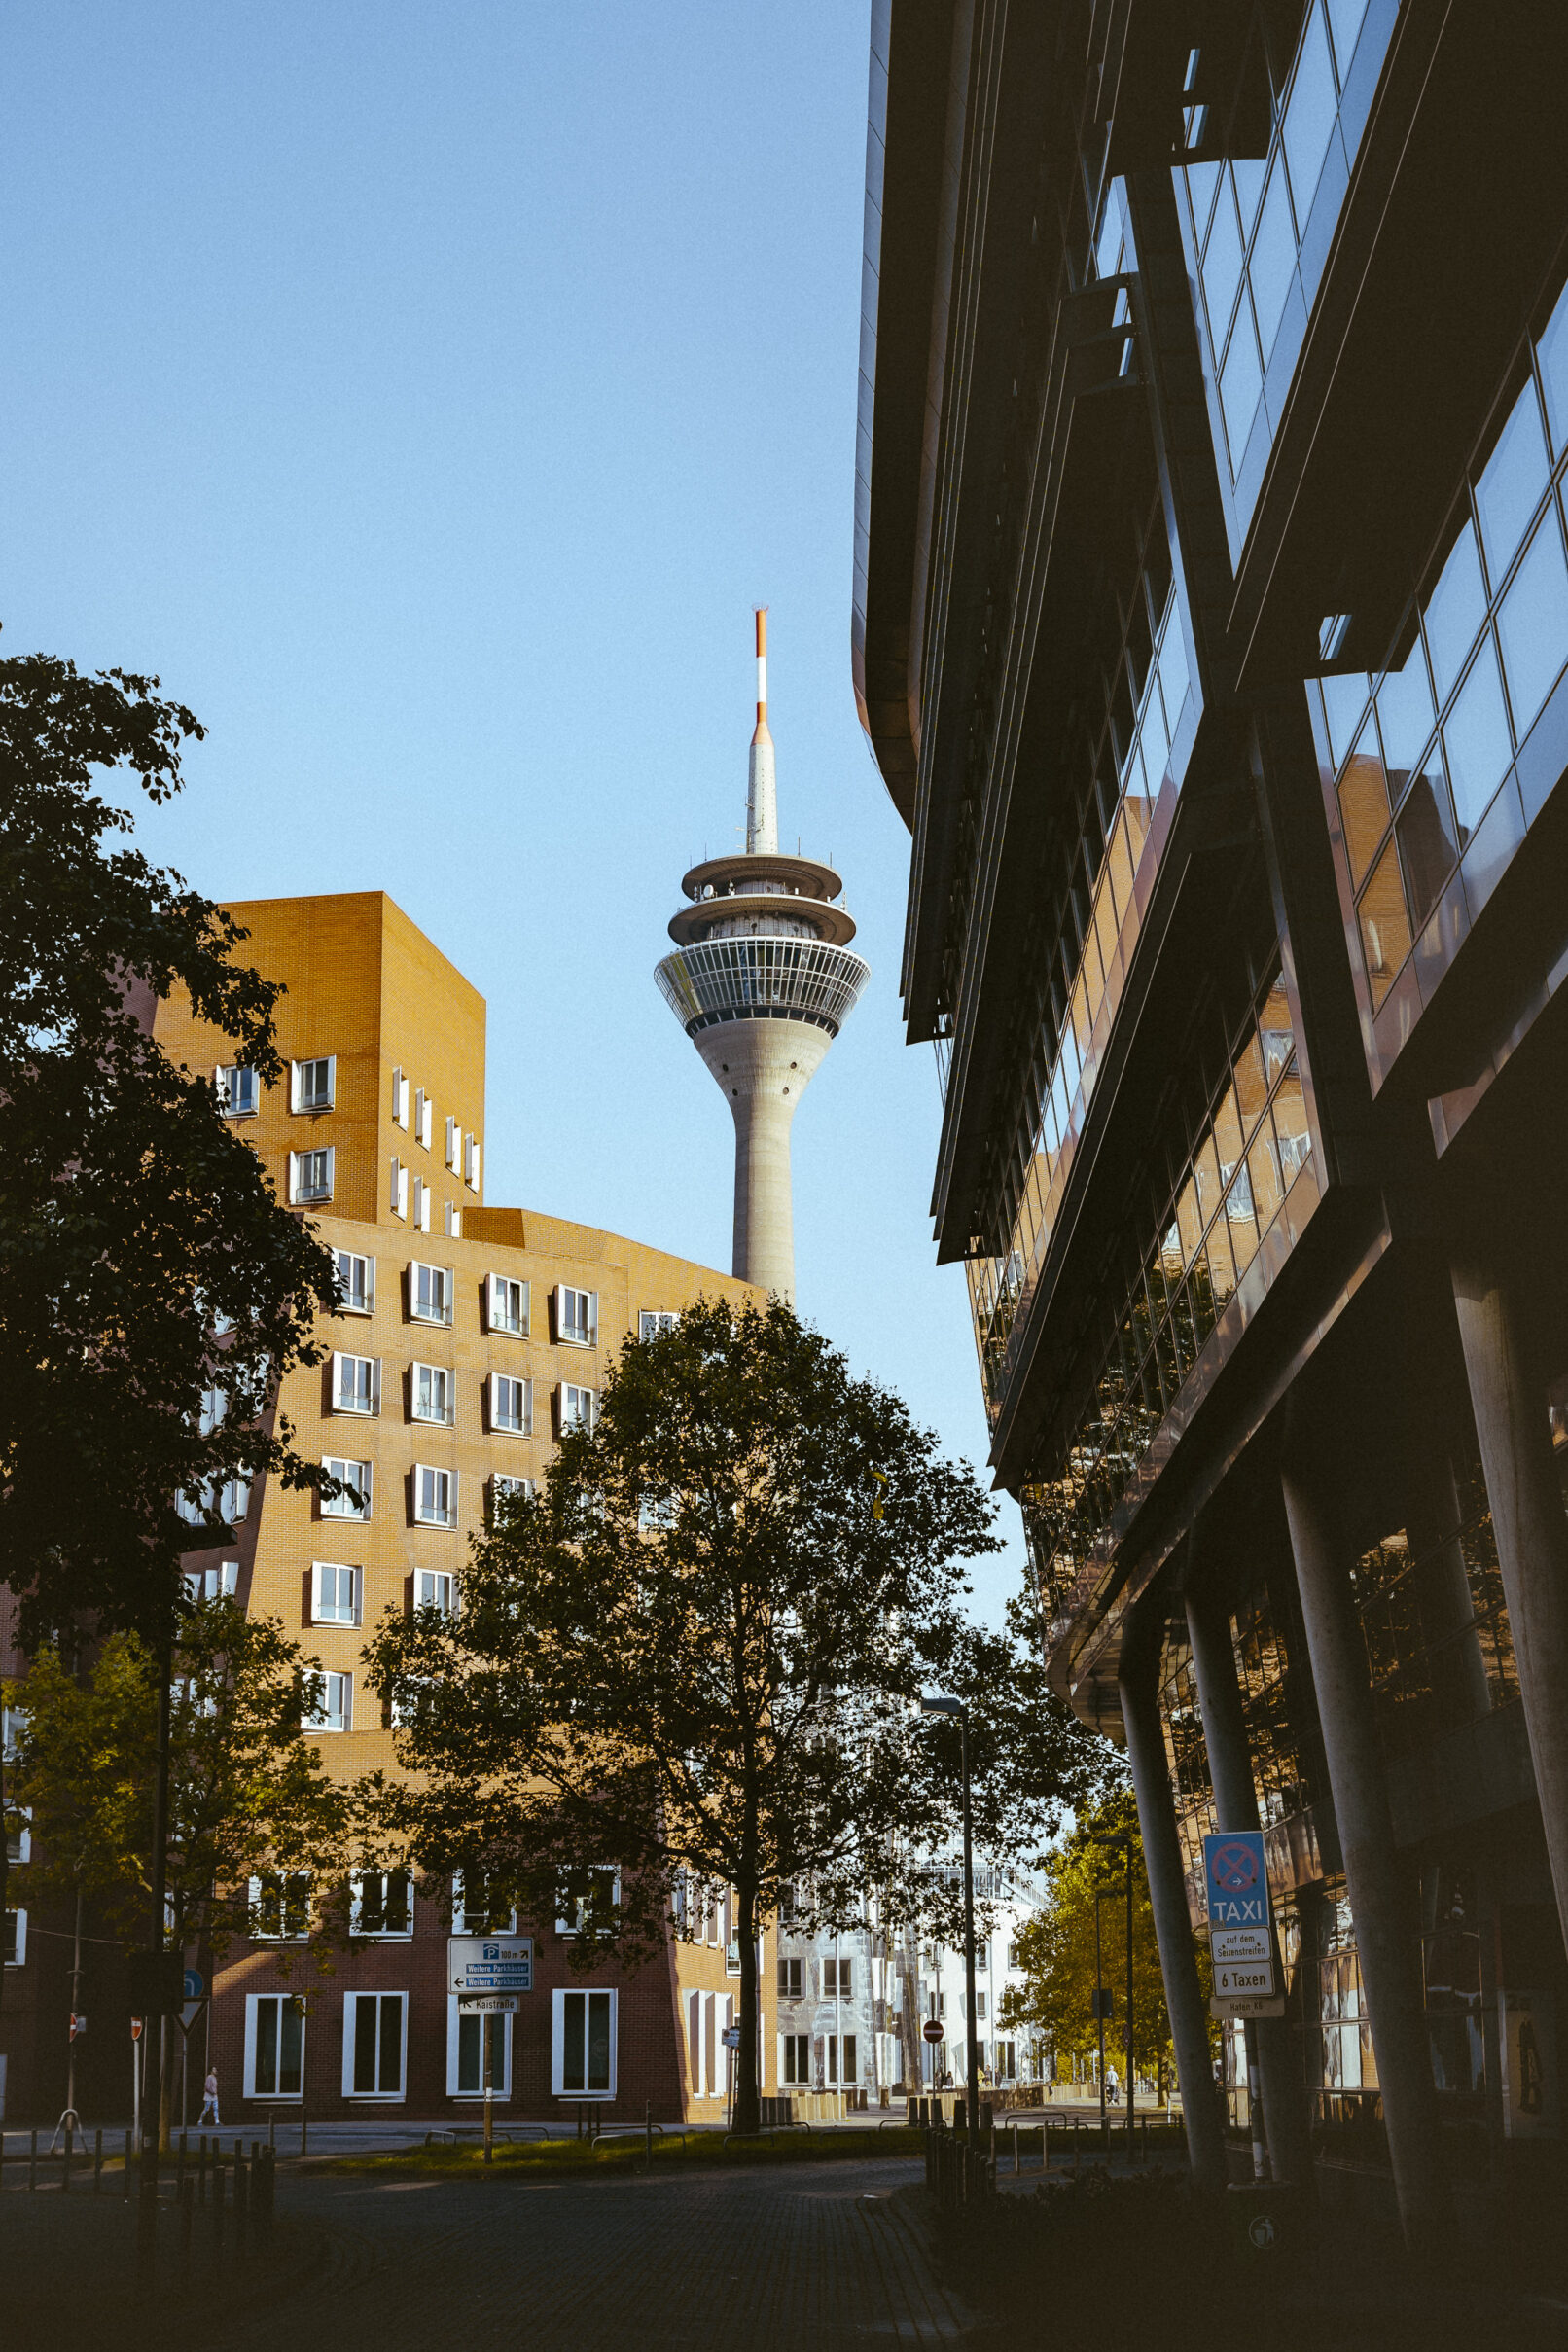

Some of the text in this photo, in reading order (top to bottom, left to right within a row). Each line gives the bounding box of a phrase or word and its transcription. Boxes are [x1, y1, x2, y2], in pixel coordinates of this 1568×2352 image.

[1213, 1900, 1263, 1922] TAXI
[1226, 1934, 1255, 1944] auf dem
[501, 1950, 512, 1959] 100
[1217, 1945, 1265, 1958] Seitenstreifen
[493, 1964, 528, 1973] Parkhäuser
[468, 1978, 528, 1986] Weitere Parkhäuser
[1222, 1972, 1266, 1987] 6 Taxen
[476, 1999, 515, 2010] Kaistraße
